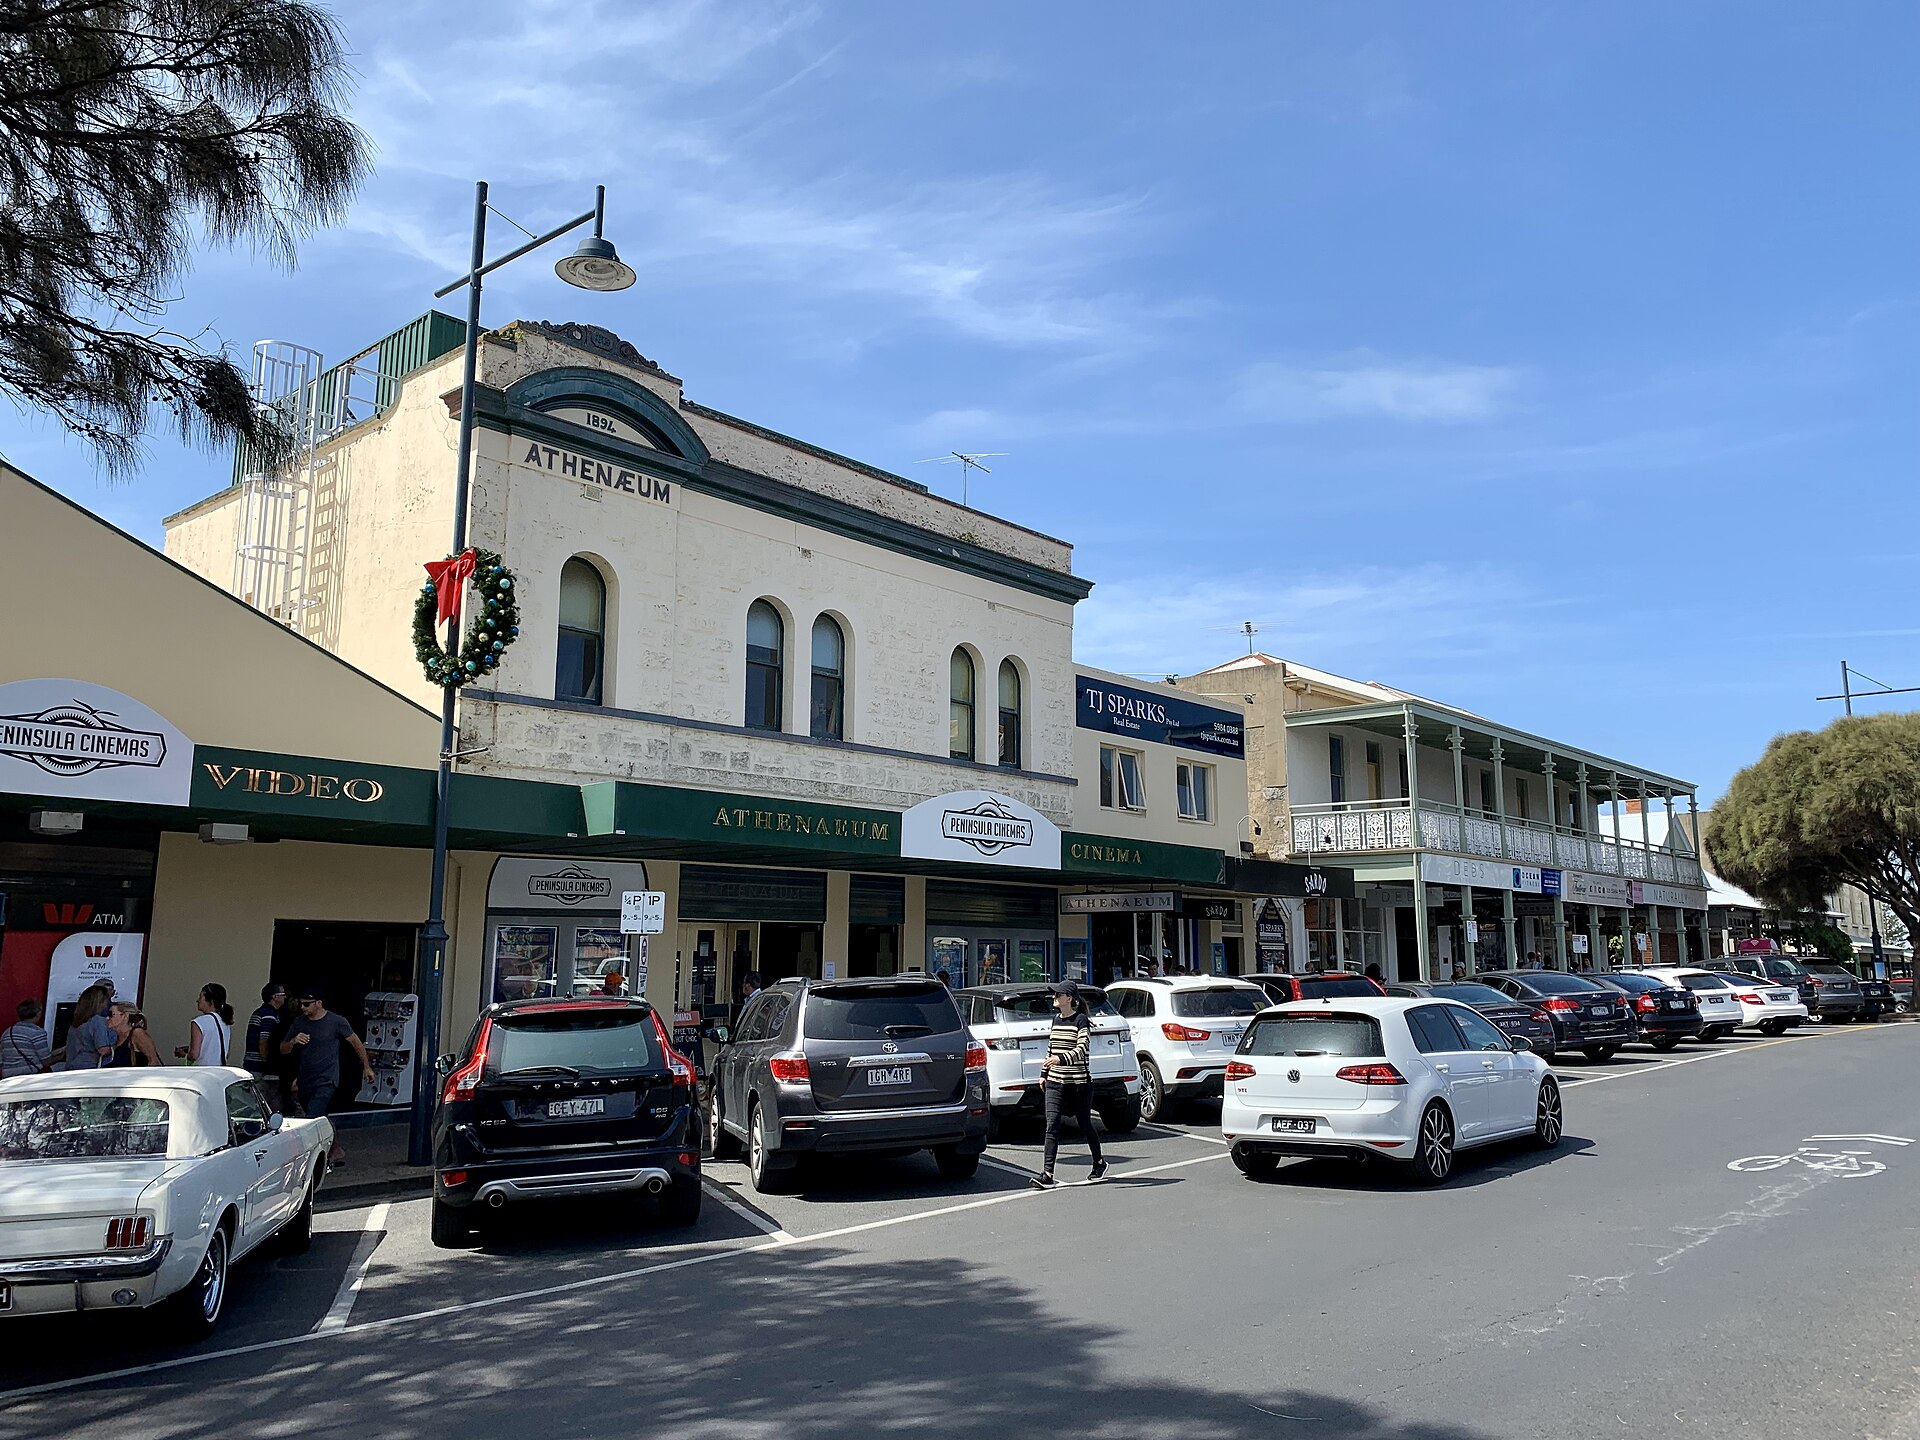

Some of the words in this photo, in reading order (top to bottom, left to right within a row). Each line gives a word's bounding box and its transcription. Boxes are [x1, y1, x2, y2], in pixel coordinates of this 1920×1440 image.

[586, 412, 617, 434] 1894
[523, 442, 672, 505] ATHENÆUM
[1086, 688, 1104, 714] TJ
[1107, 693, 1166, 724] SPARKS
[1113, 716, 1125, 728] Real
[1125, 719, 1141, 731] Estate
[0, 725, 75, 751] NINSULA
[79, 733, 150, 759] CINEMAS
[202, 762, 384, 803] VIDEO
[712, 806, 889, 842] ATHENAEUM
[950, 817, 992, 836] PENINSULA
[994, 822, 1026, 840] CINEMAS
[1070, 843, 1143, 865] CINEMA
[1453, 860, 1485, 879] DEBS
[1521, 871, 1540, 881] OCEAN
[536, 880, 574, 892] PENINSULA
[575, 881, 605, 893] CINEMAS
[1304, 872, 1327, 894] SARDO
[648, 895, 660, 906] 1P
[1065, 896, 1172, 909] ATHENAEUM
[92, 913, 124, 925] ATM
[1205, 905, 1228, 918] SARDO
[87, 962, 106, 970] ATM
[892, 1067, 910, 1082] 4RF
